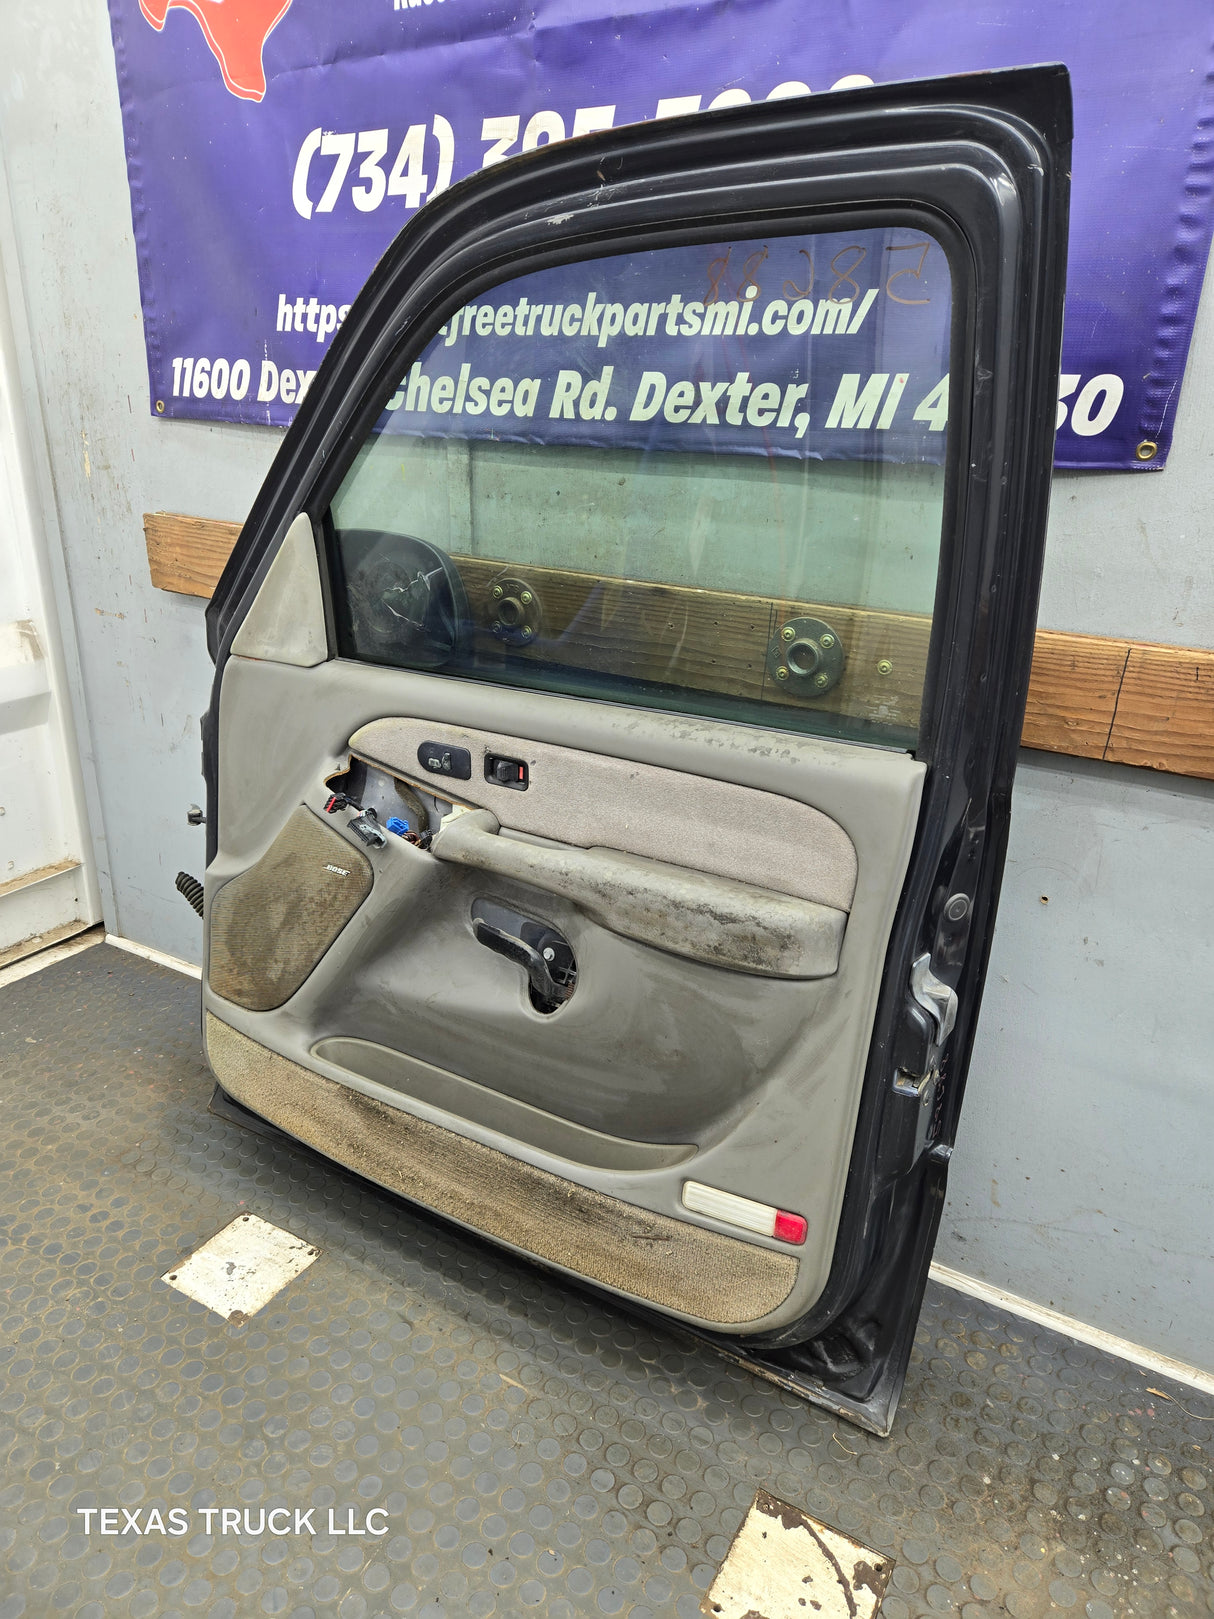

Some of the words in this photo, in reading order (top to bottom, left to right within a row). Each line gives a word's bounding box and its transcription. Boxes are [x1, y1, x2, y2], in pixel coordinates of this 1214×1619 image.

[292, 114, 454, 220] (734)
[171, 357, 251, 400] 11600
[548, 366, 617, 421] Rd.
[629, 371, 810, 438] Dexter,
[825, 373, 910, 429] MI
[322, 864, 351, 877] BOSE
